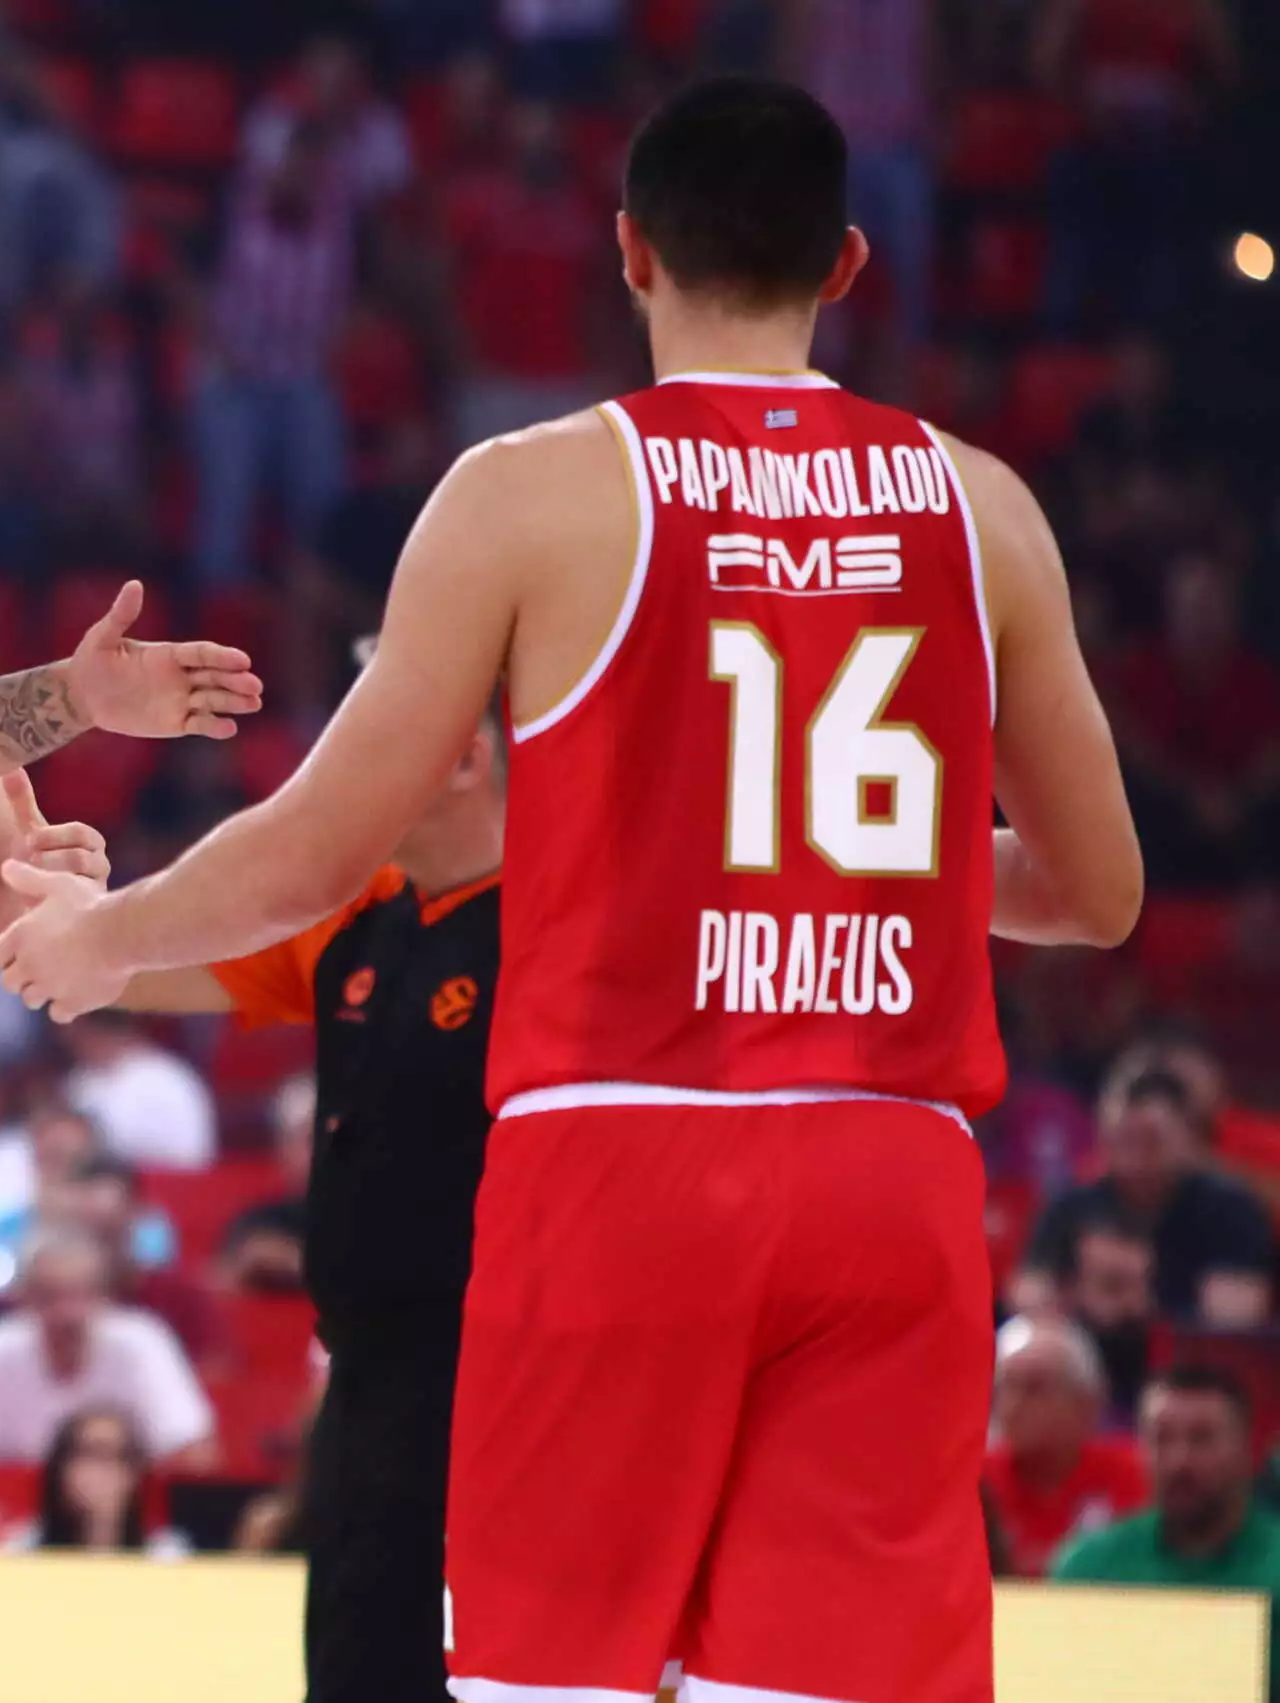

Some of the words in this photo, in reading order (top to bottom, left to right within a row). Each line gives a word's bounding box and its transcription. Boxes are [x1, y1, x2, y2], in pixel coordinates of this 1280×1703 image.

[645, 436, 949, 519] PAPANIKOLAOU
[707, 534, 902, 590] FMS
[709, 619, 944, 878] 16
[695, 909, 913, 1016] PIRAEUS
